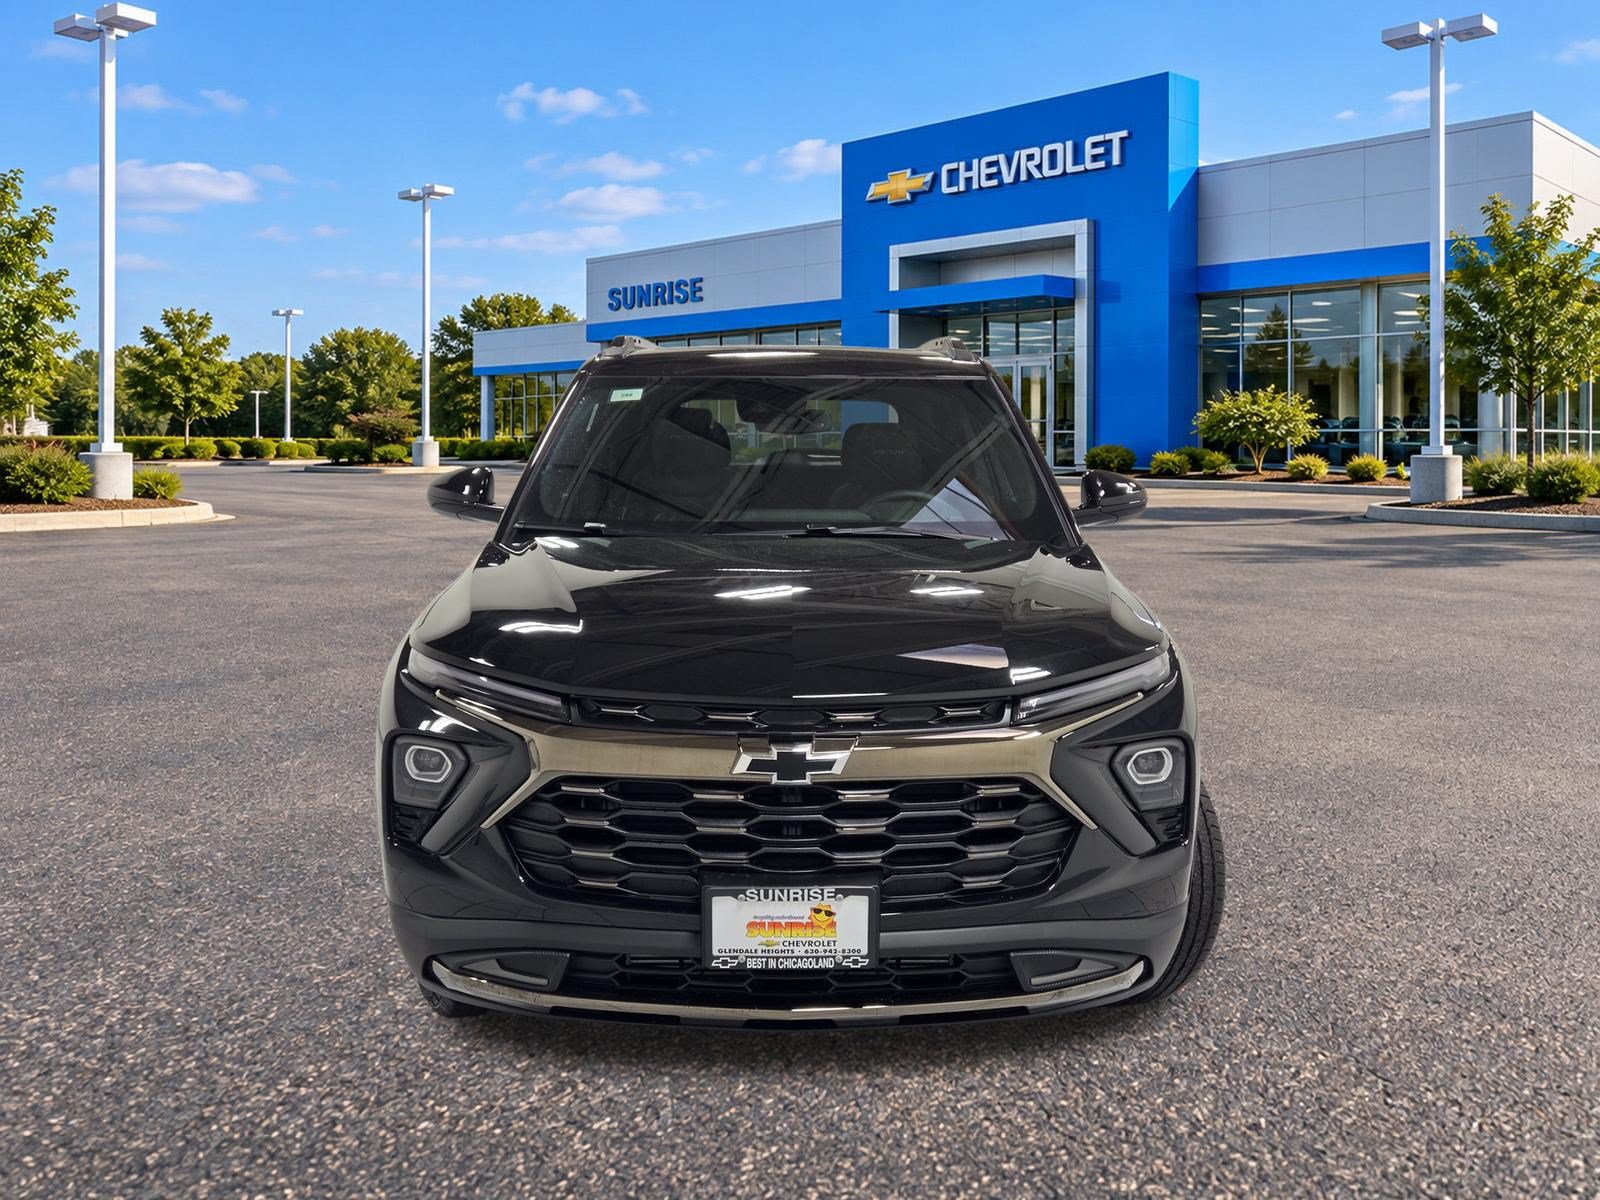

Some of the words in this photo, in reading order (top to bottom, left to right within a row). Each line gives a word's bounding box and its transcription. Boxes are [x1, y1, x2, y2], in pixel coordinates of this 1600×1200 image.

[941, 130, 1129, 194] CHEVROLET
[608, 277, 704, 311] SUNRISE
[746, 888, 836, 901] SUNRISE
[745, 921, 837, 938] SUNRISE
[782, 940, 838, 948] CHEVROLET
[746, 958, 766, 969] BEST
[769, 958, 776, 969] IN
[778, 957, 835, 969] CHICAGOLAND
